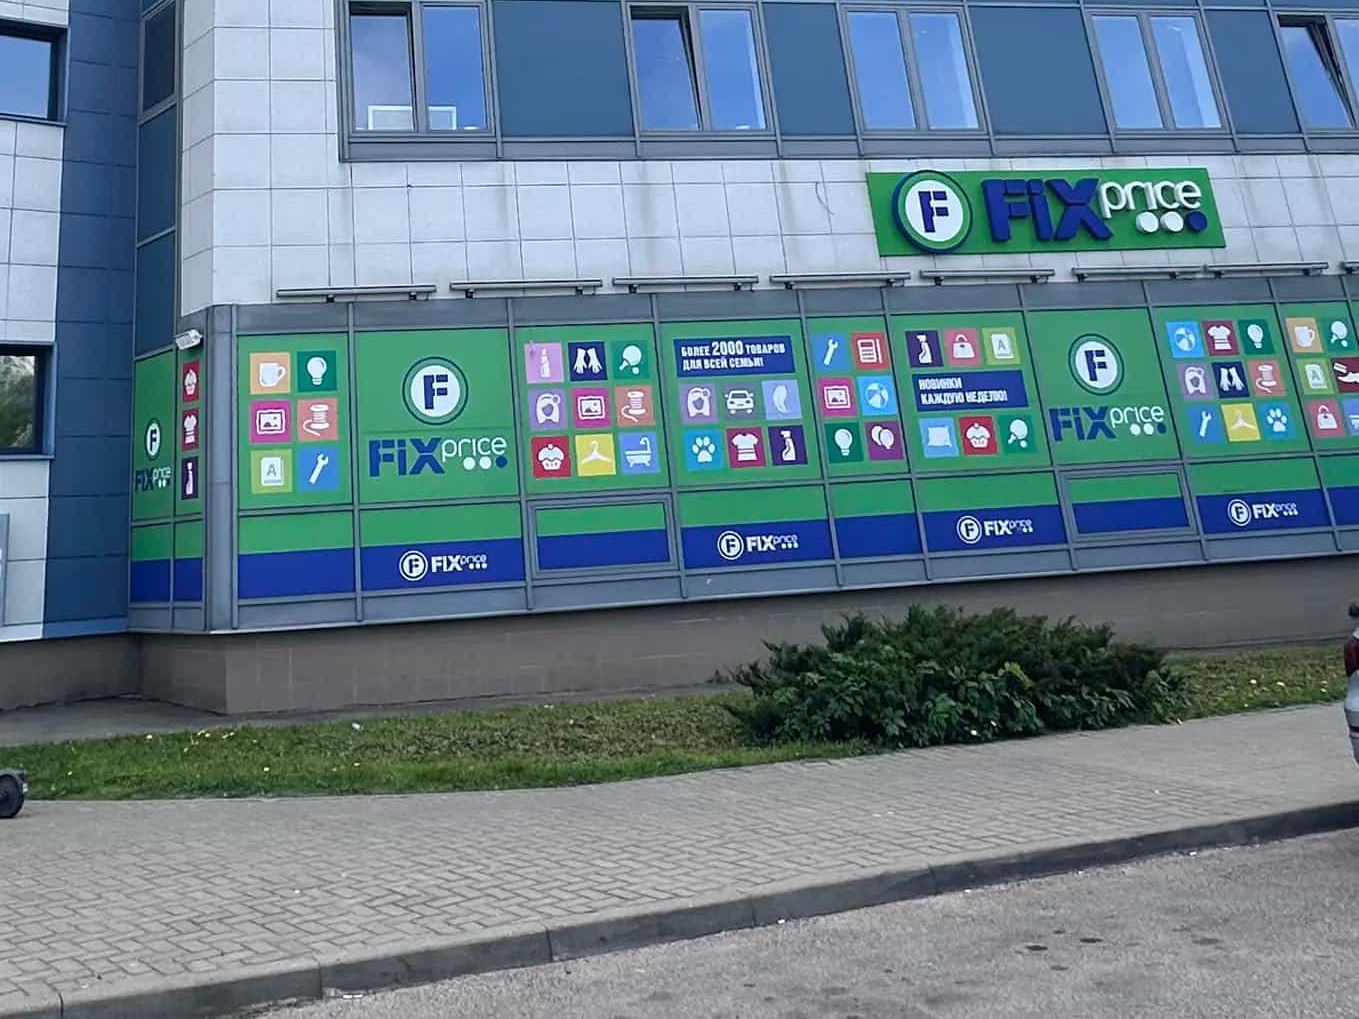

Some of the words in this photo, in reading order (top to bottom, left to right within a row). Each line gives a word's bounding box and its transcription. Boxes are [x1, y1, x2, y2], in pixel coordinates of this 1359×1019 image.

[681, 345, 710, 357] БОЛЕЕ
[711, 340, 744, 356] 2000
[745, 343, 786, 354] ТОВАРОВ
[682, 359, 702, 371] ДЛЯ
[703, 357, 728, 369] ВСЕЙ
[920, 391, 965, 405] КАЖДУЮ
